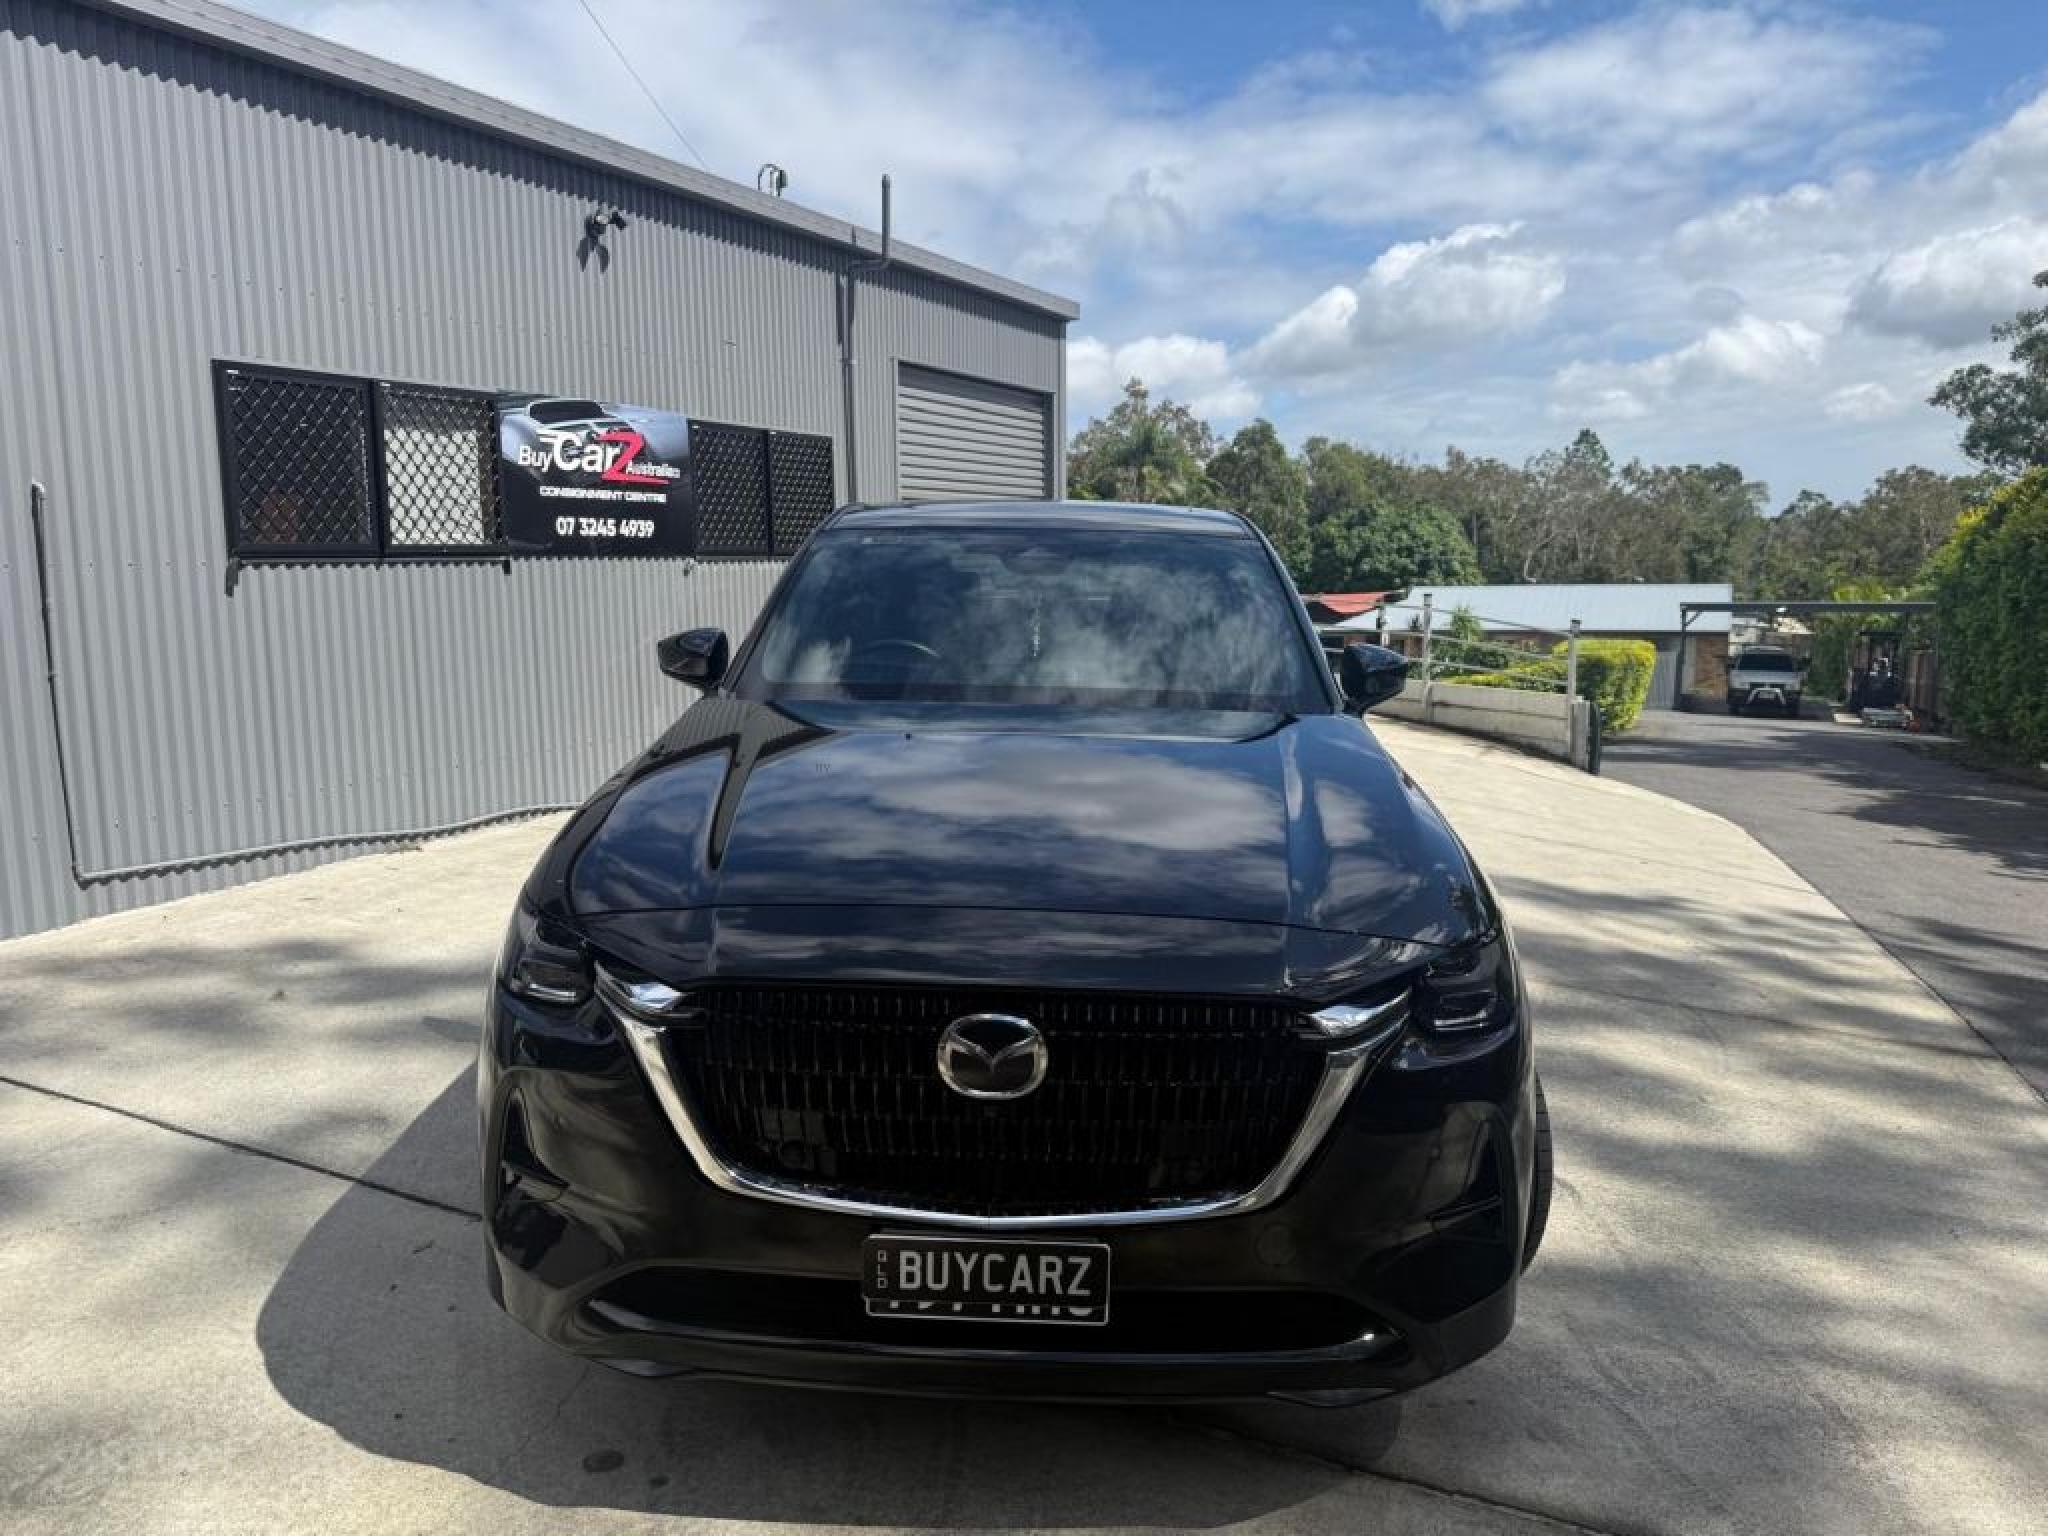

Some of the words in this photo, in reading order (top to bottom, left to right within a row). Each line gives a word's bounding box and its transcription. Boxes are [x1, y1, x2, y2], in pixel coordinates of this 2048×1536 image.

[556, 516, 575, 536] 07
[579, 517, 617, 537] 3245
[620, 519, 655, 538] 4939
[899, 1250, 1092, 1297] BUYCARZ
